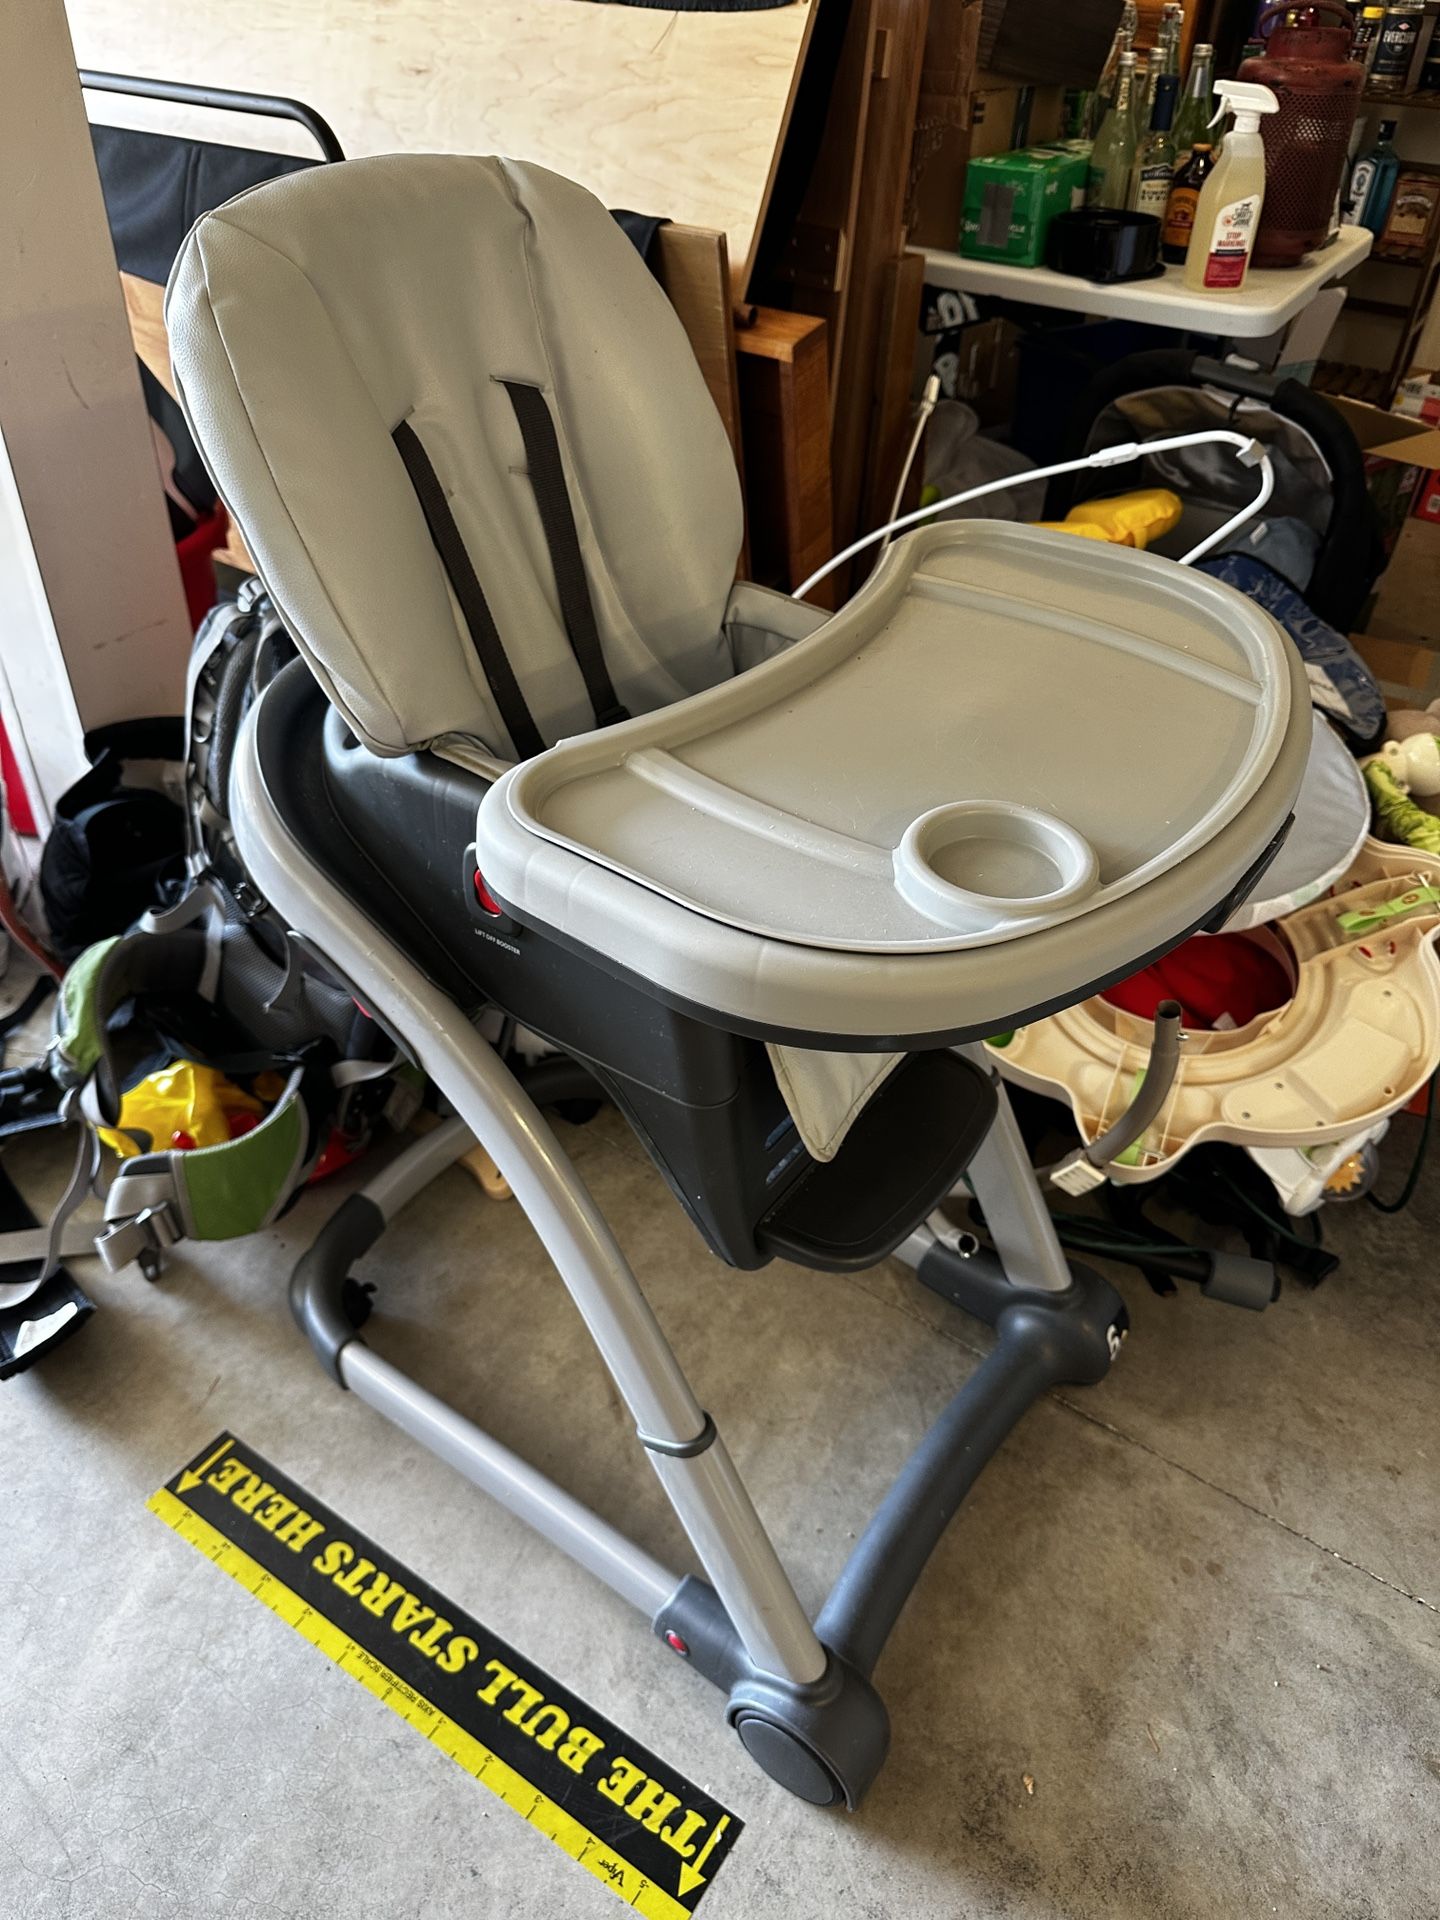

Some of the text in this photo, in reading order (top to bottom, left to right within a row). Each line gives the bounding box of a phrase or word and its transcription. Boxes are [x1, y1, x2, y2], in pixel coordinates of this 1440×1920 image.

[1226, 232, 1242, 240] STOP
[474, 928, 520, 954] LIFT OFF BOOSTER
[207, 1457, 707, 1857] THE BULL STARTS HERE
[356, 1650, 436, 1716] AXIS RECTIFIER SCALE
[484, 1753, 494, 1763] -2
[533, 1794, 544, 1804] -3
[585, 1836, 596, 1846] -4
[597, 1859, 626, 1888] Viper
[639, 1879, 649, 1889] -5
